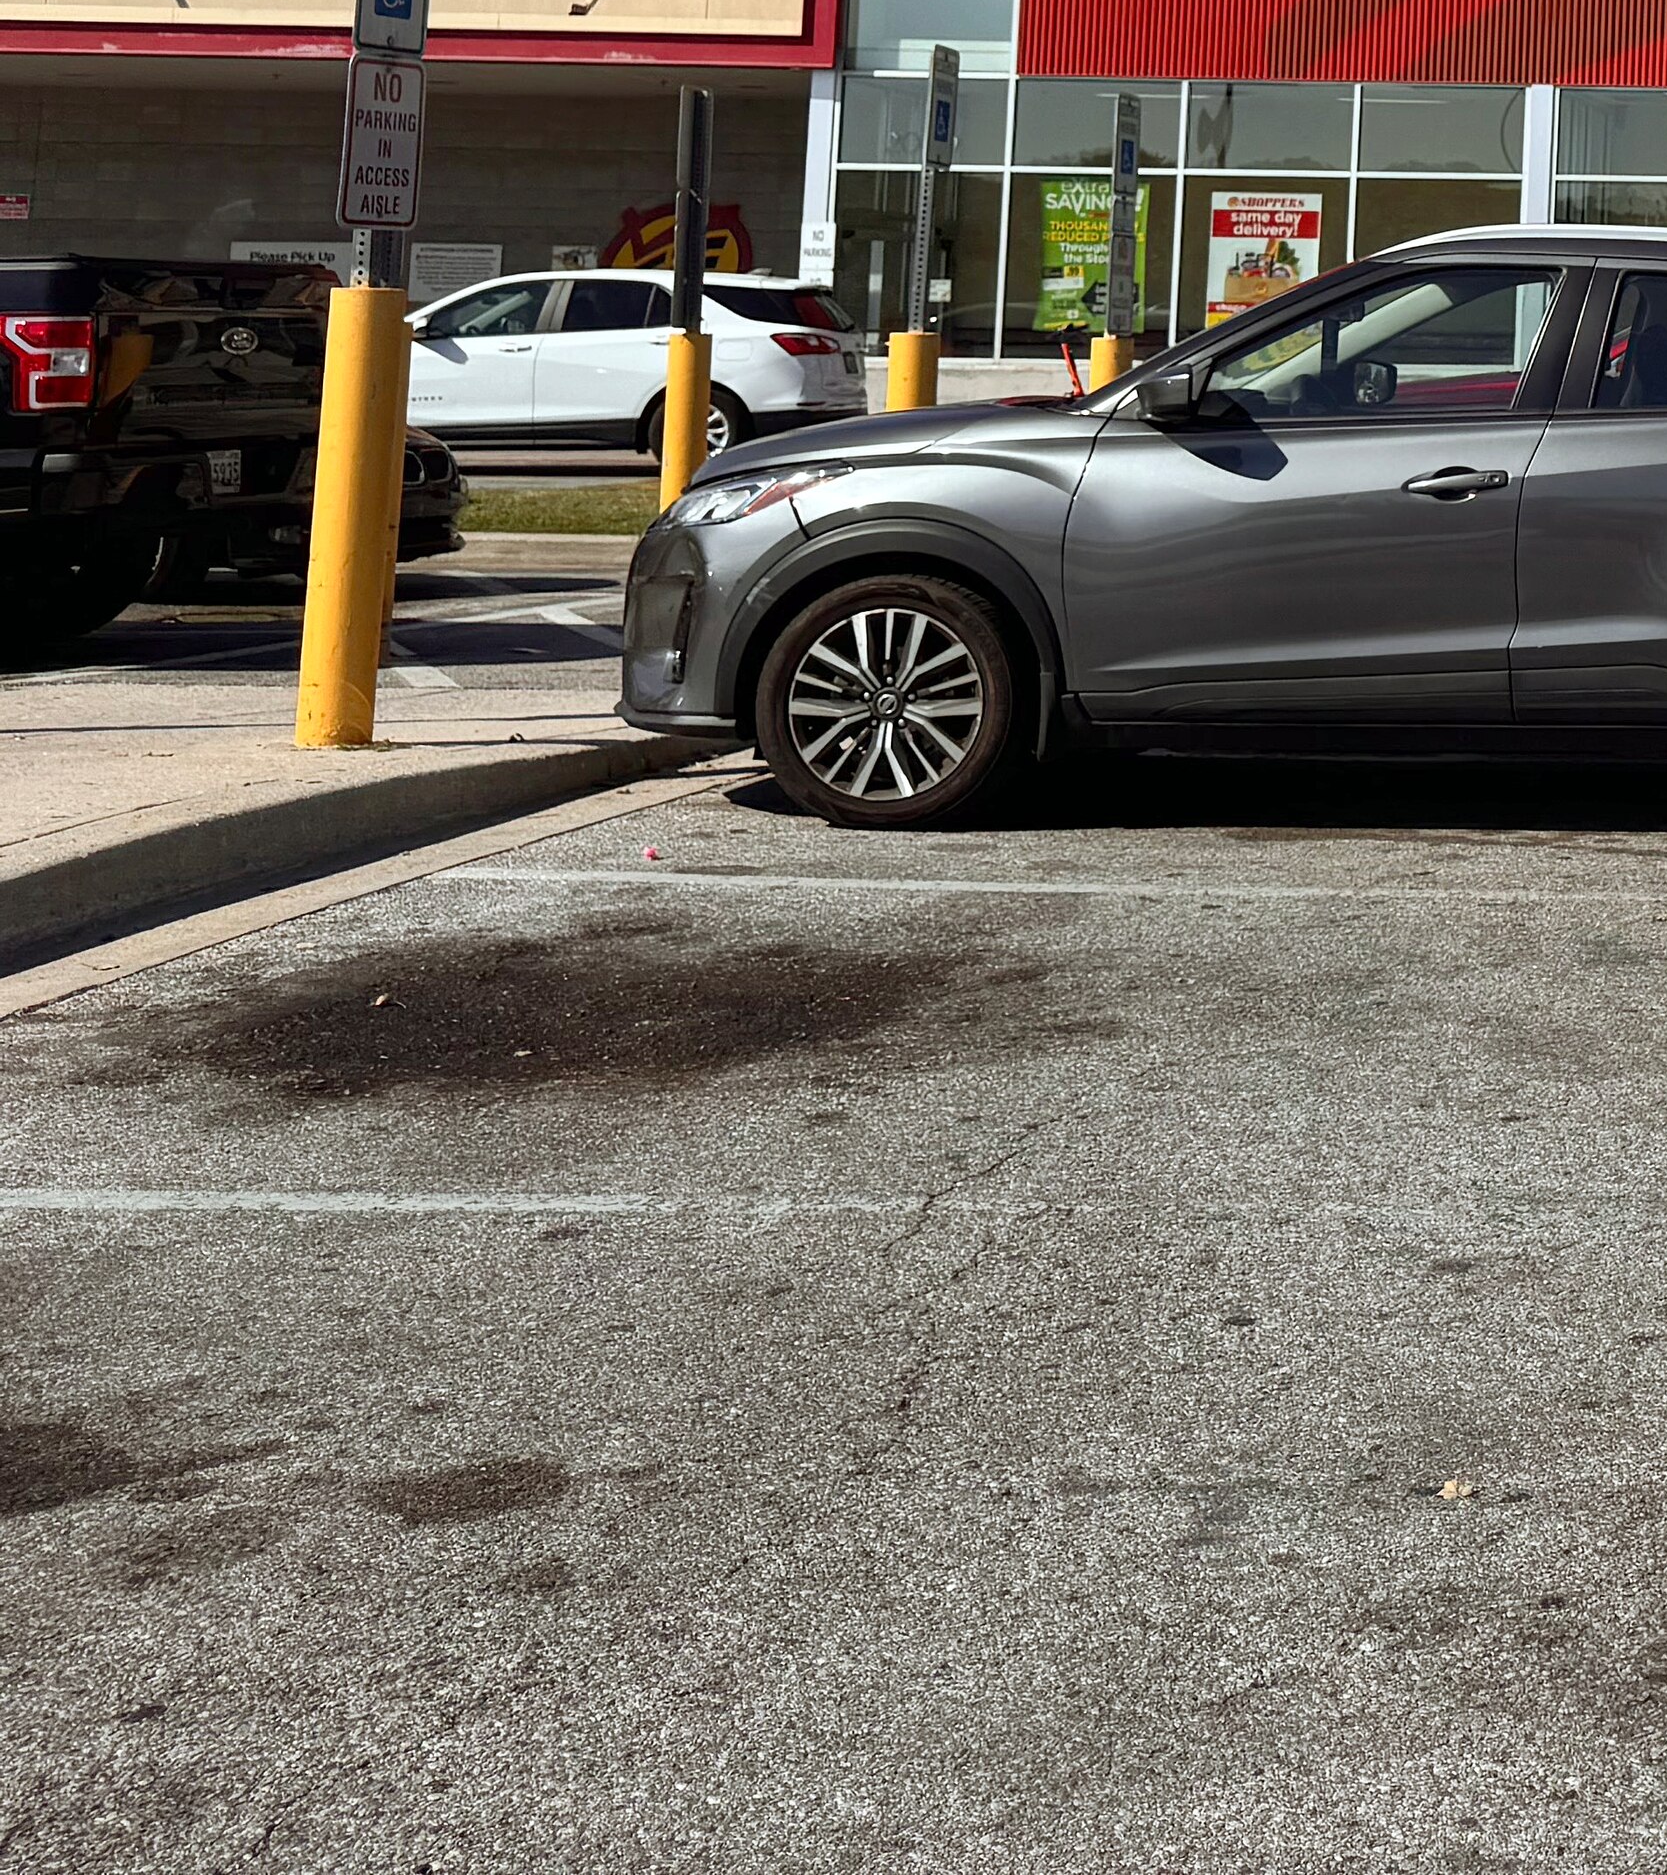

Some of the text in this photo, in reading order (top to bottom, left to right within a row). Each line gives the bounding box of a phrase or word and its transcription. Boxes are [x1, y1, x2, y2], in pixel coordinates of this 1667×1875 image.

[374, 72, 403, 103] NO
[355, 109, 417, 133] PARKING
[378, 138, 393, 159] IN
[354, 165, 410, 187] ACCESS
[360, 194, 401, 215] AISLE
[1240, 197, 1305, 208] SHOPPERS
[1231, 211, 1302, 226] same day
[812, 230, 824, 242] NO
[1233, 223, 1299, 238] delivery!
[318, 252, 335, 263] Up
